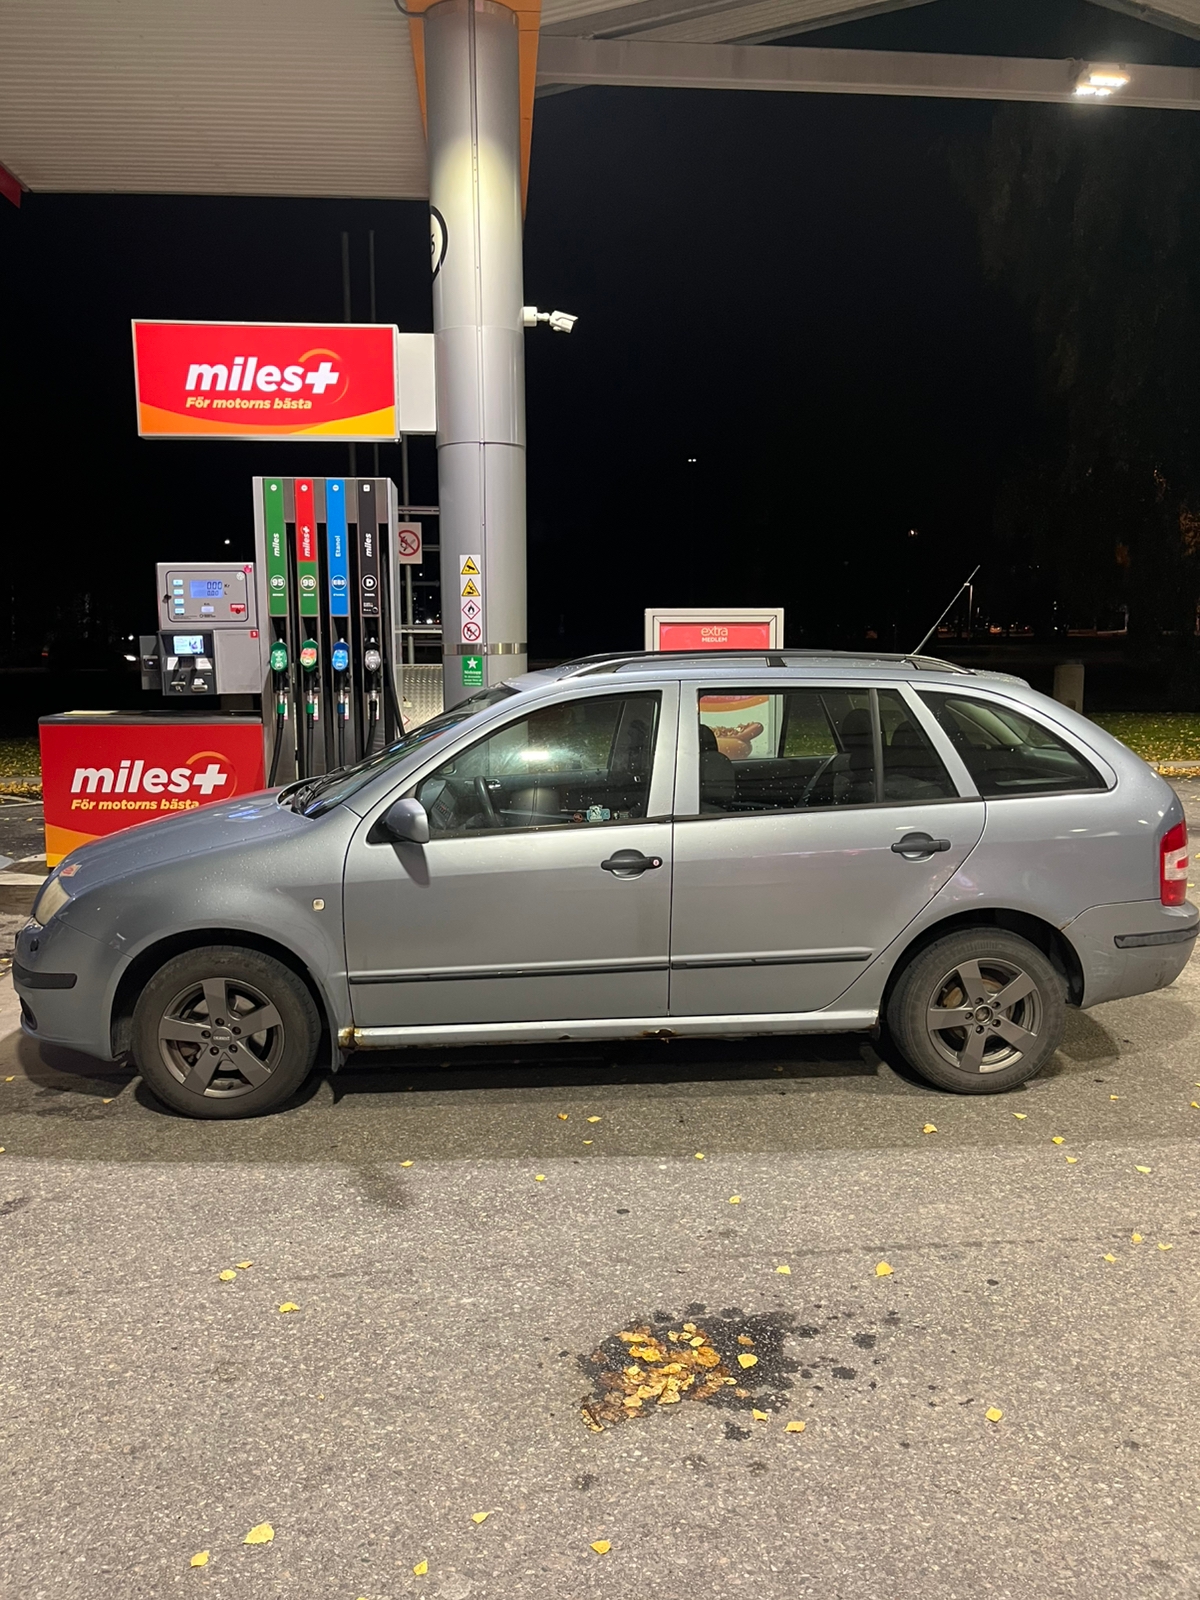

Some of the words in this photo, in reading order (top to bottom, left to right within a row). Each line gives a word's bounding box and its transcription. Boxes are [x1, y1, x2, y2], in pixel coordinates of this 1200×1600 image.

[185, 356, 340, 394] miles+
[186, 396, 211, 410] För
[212, 397, 271, 410] motorns
[273, 396, 312, 410] bästa
[302, 525, 311, 558] miles+
[364, 532, 373, 558] miles
[271, 578, 284, 586] 95
[302, 579, 315, 587] 98
[365, 578, 374, 586] D
[700, 625, 729, 636] extra
[70, 759, 228, 795] miles+
[71, 798, 97, 810] För
[98, 799, 158, 810] motorns
[160, 798, 200, 810] bästa
